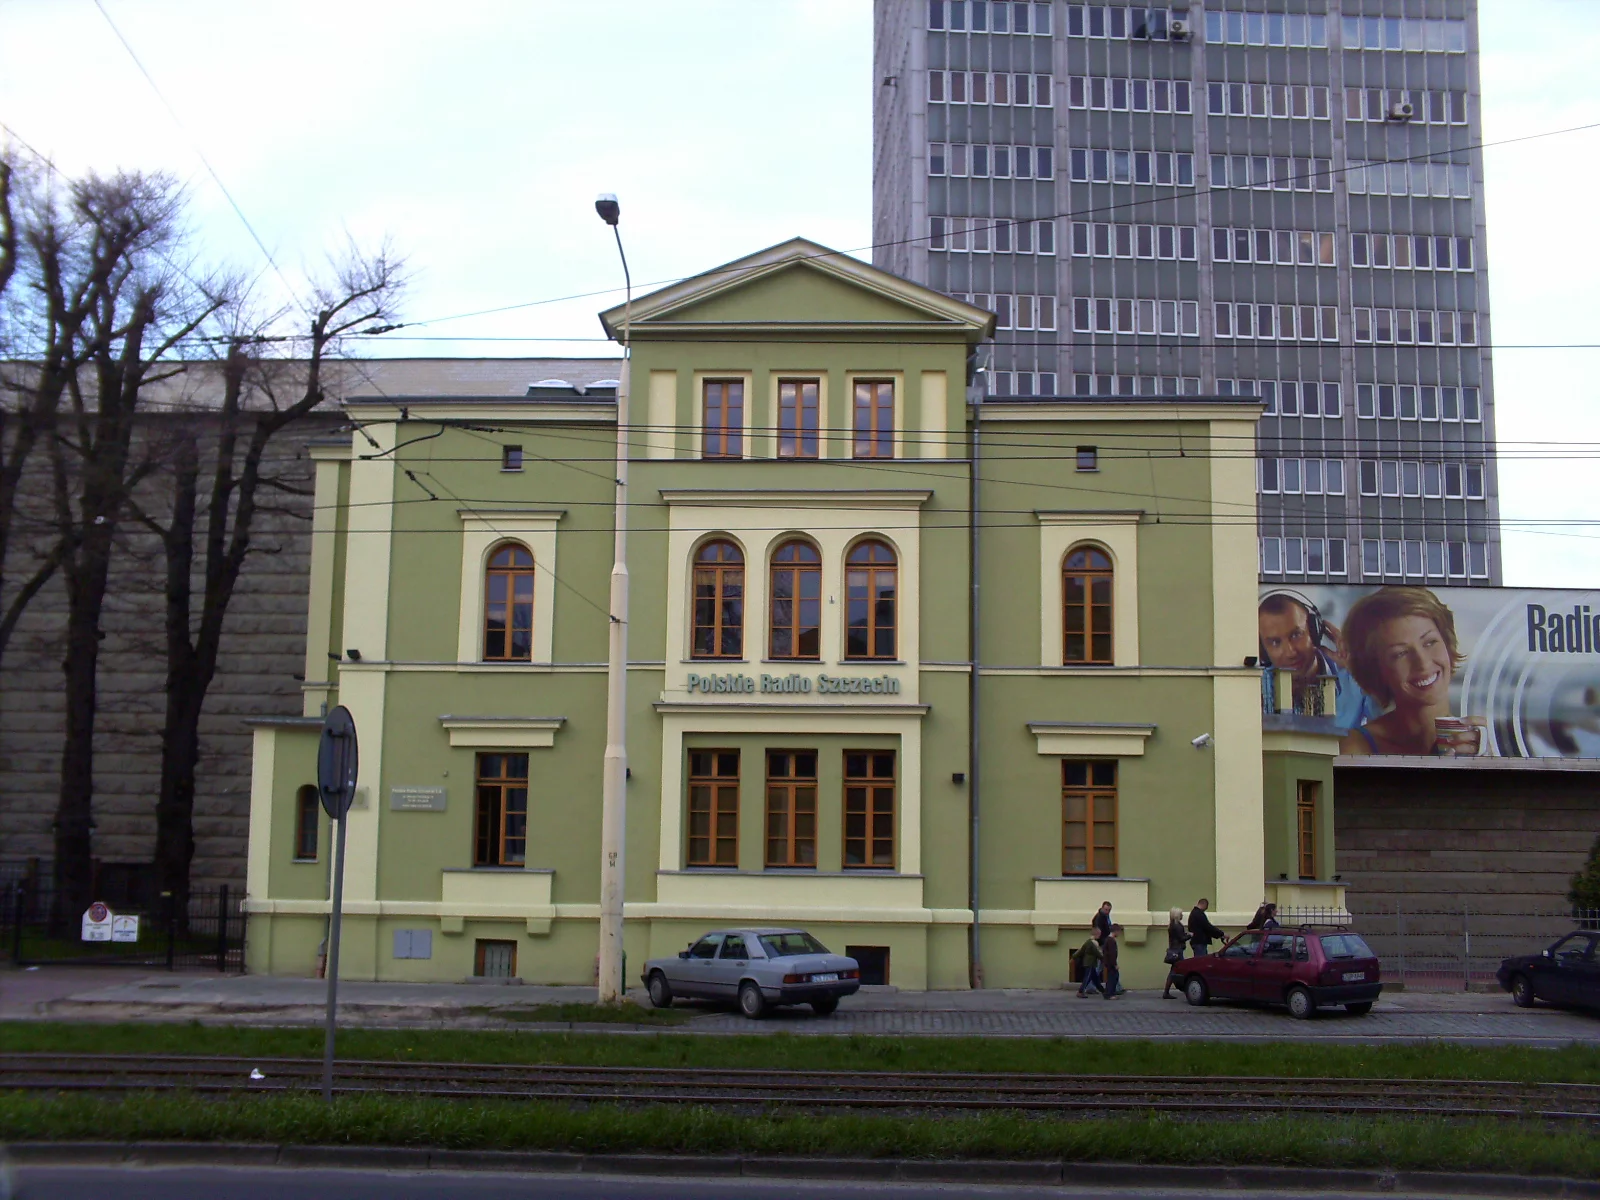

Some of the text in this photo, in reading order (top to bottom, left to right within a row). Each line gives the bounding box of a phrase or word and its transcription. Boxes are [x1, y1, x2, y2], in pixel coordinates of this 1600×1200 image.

[687, 673, 900, 694] Polskie Radio Szczecin
